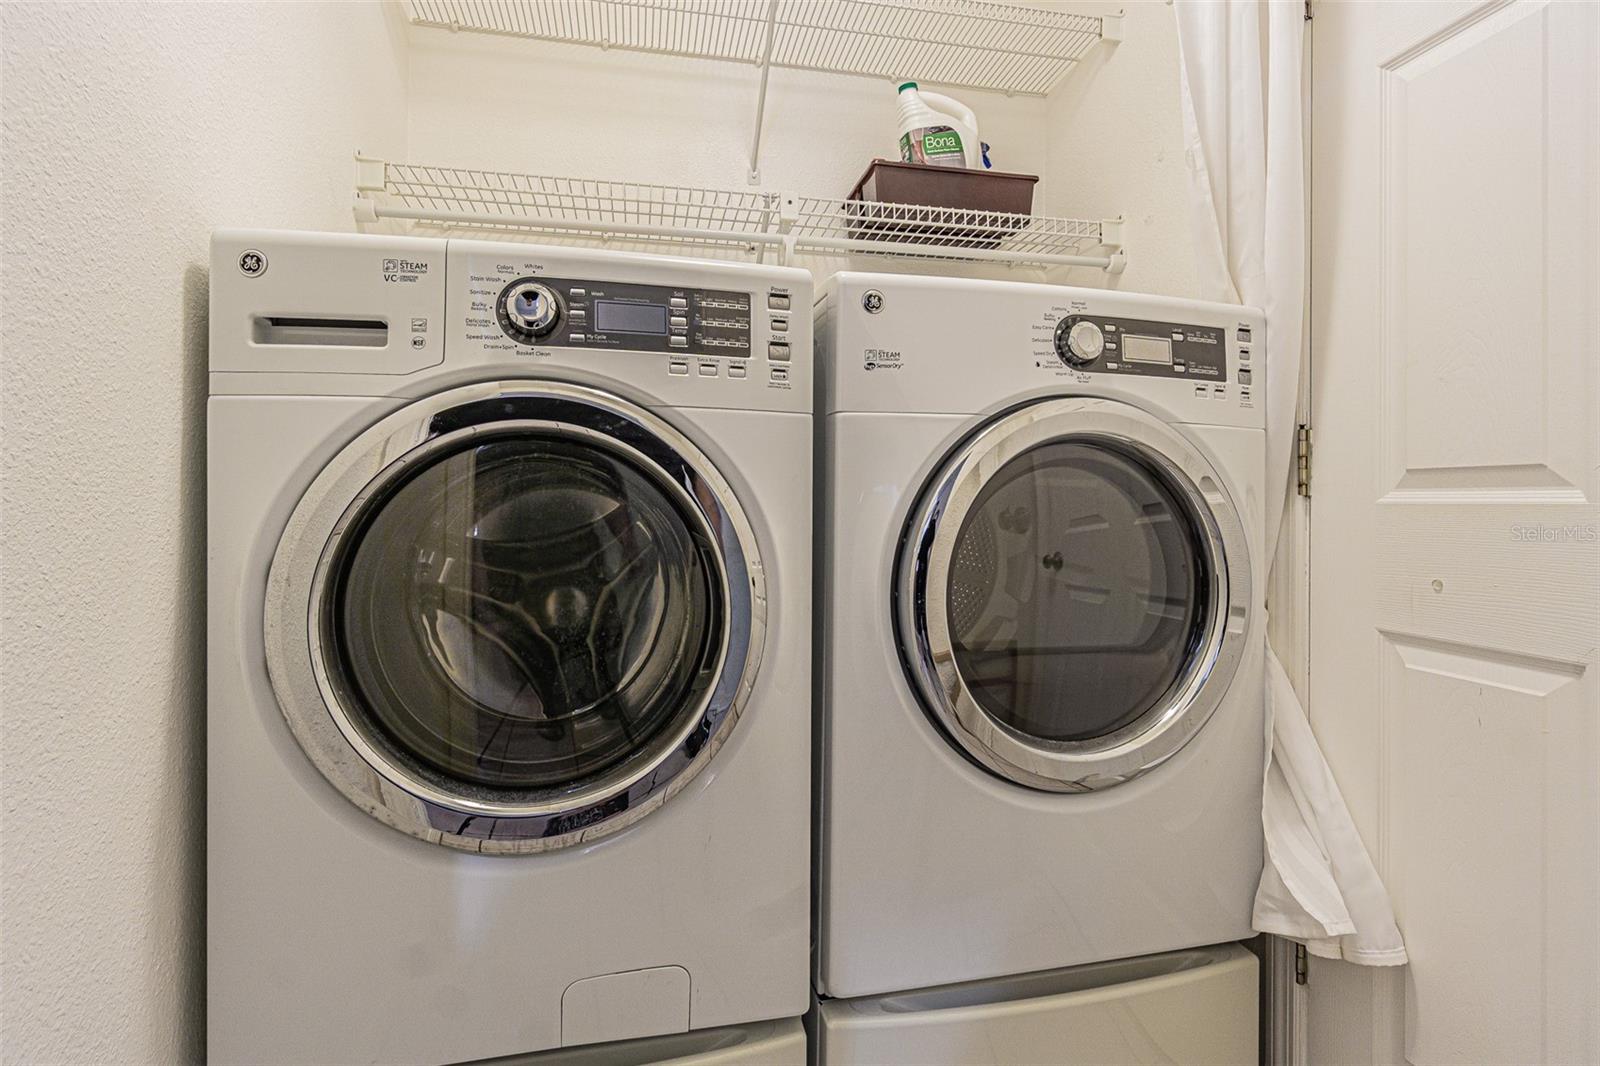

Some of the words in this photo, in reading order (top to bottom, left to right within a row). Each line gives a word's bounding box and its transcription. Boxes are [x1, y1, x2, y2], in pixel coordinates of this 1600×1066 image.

[925, 136, 956, 148] Bona
[400, 262, 428, 270] STEAM
[383, 274, 398, 282] VC
